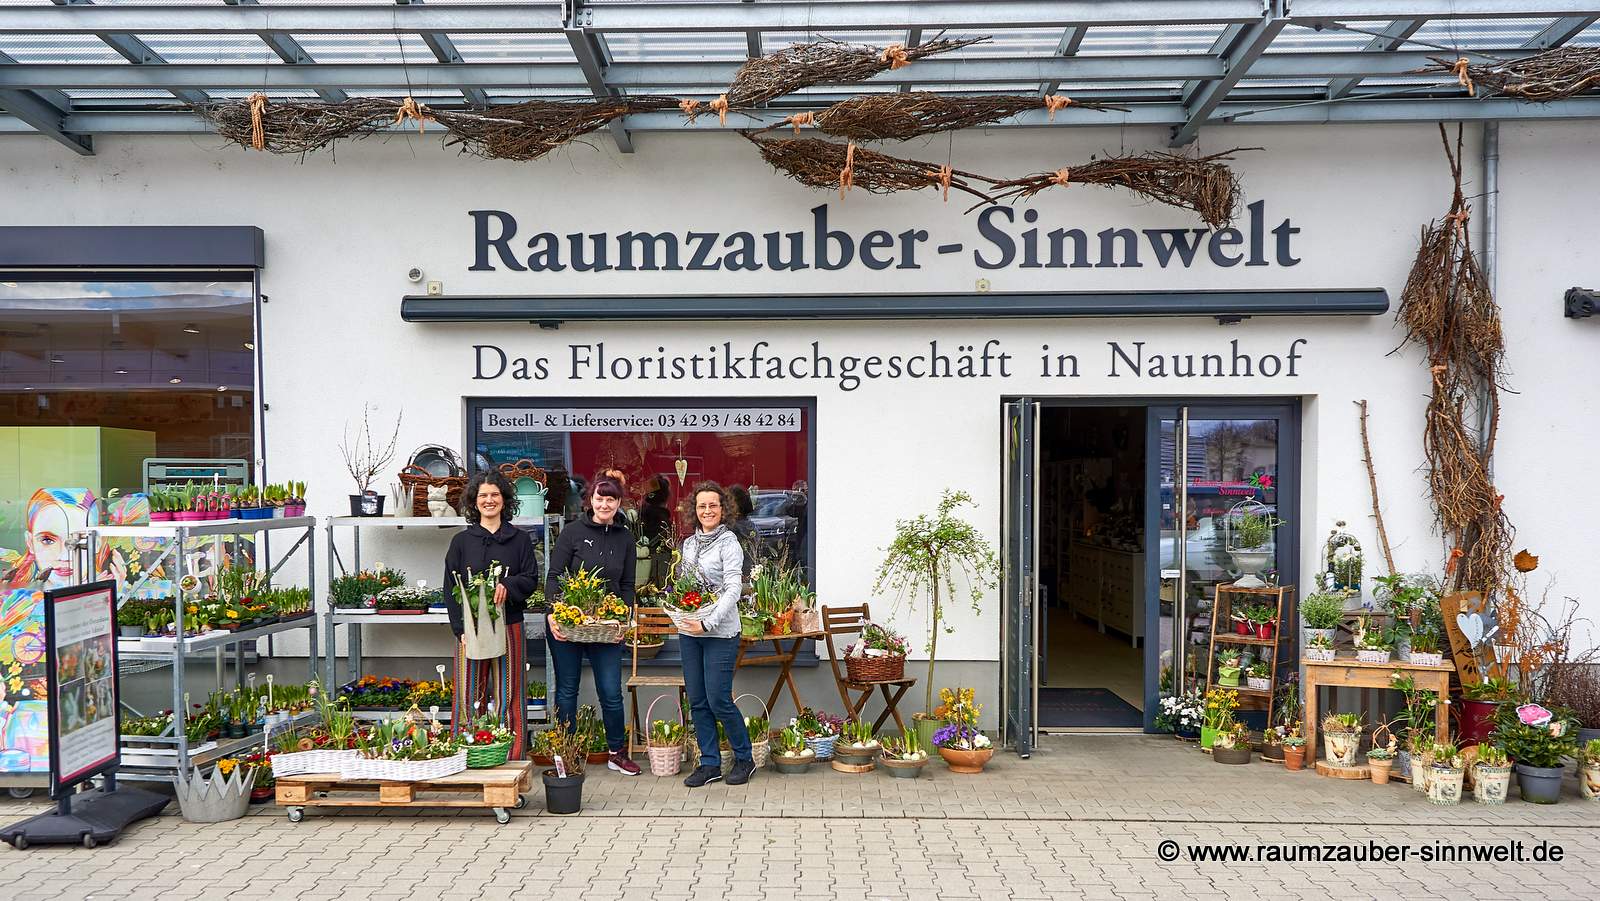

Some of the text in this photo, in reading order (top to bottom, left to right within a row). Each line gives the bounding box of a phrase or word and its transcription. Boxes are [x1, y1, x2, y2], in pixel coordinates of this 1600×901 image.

[468, 200, 1301, 272] Raumzauber-Sinnwelt
[472, 339, 1308, 392] Das Floristikfachgeschäft in Naunhof
[488, 412, 796, 428] Bestell- & Lieferservice: 03 42 93 / 48 42 84
